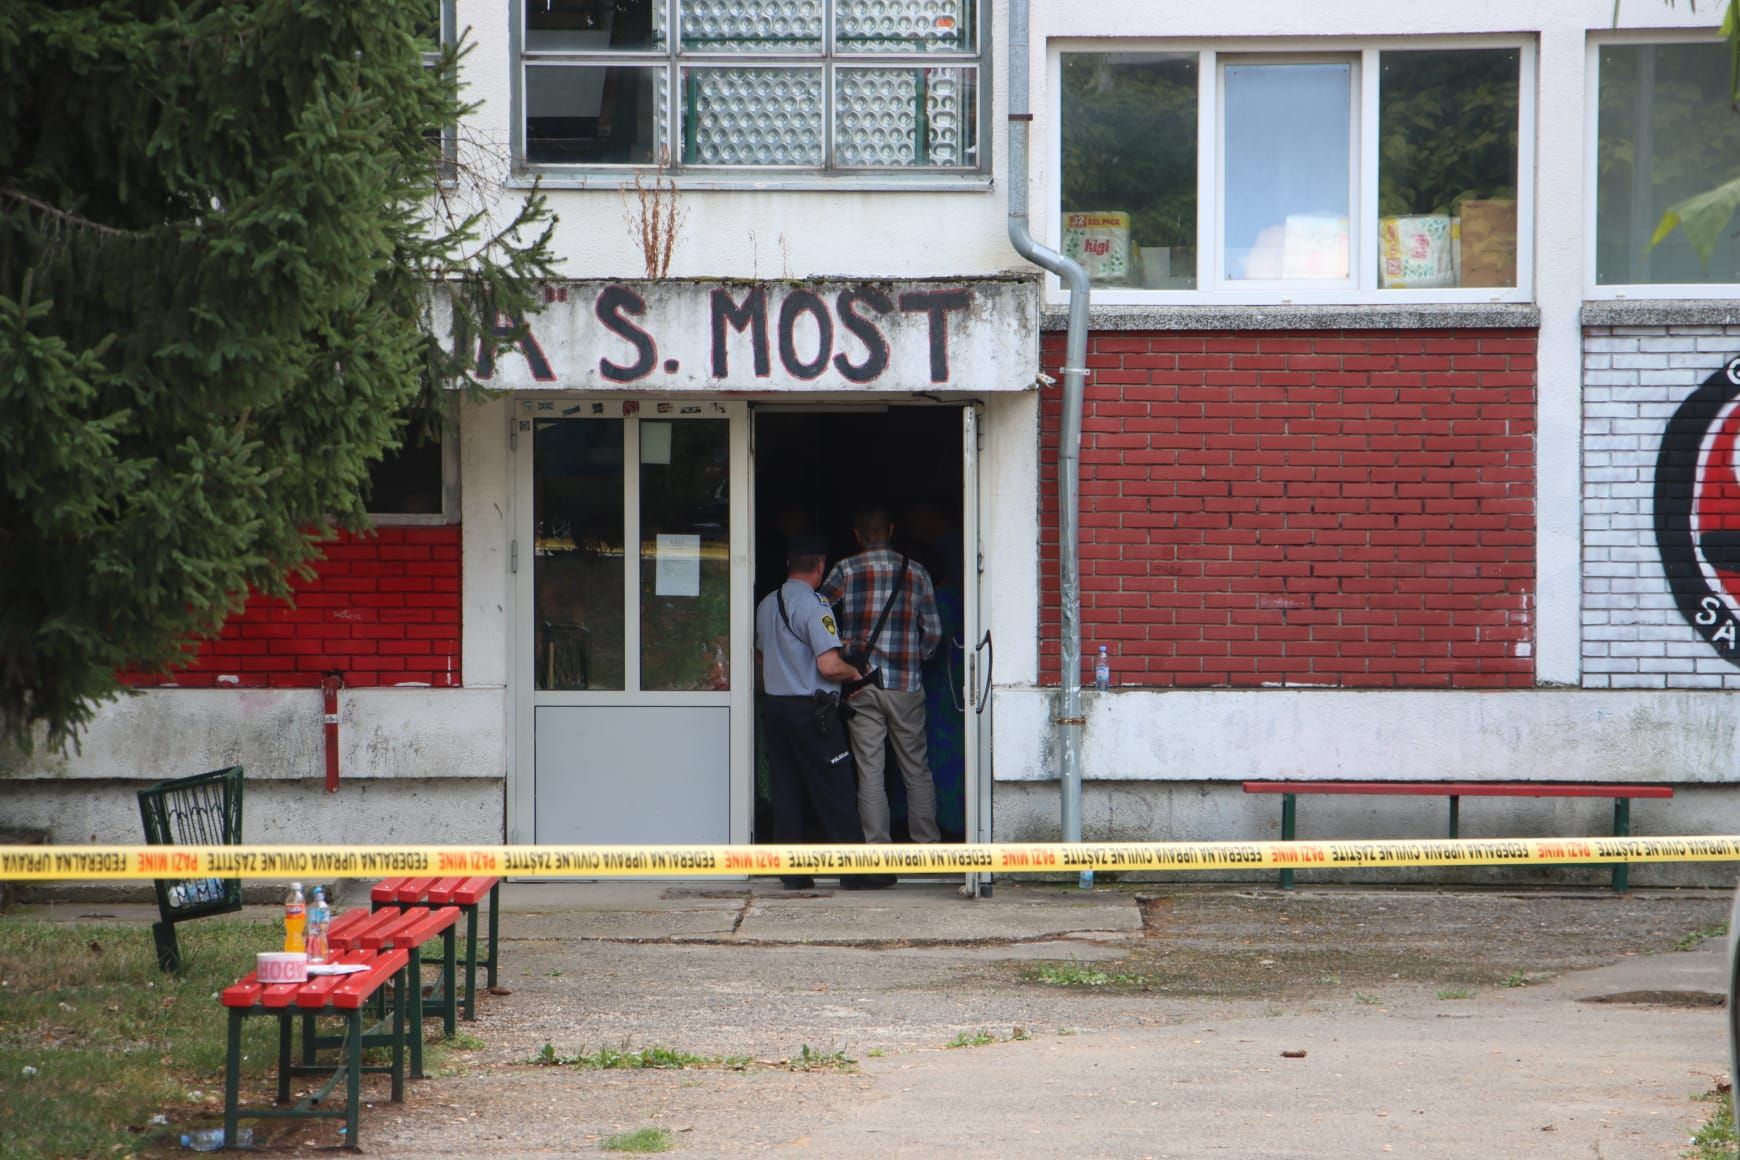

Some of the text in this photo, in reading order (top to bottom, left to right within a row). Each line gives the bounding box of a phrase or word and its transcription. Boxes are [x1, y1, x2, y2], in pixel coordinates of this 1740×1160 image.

[595, 284, 680, 384] S.
[710, 284, 972, 384] MOST
[1156, 847, 1198, 864] UPRAVA
[1201, 846, 1263, 864] FEDERALNA
[1271, 846, 1298, 863] MINE
[1301, 845, 1325, 862] PAZI
[1379, 844, 1421, 861] CIVILNE
[1423, 844, 1465, 860] UPRAVA
[1468, 843, 1529, 859] FEDERALNA
[1537, 842, 1565, 859] MINE
[1567, 842, 1591, 858] PAZI
[1644, 840, 1686, 857] CIVILNE
[1688, 839, 1731, 855] UPRAVA
[0, 851, 53, 872] UPRAVA
[55, 851, 129, 872] FEDERALNA
[135, 851, 168, 872] MINE
[169, 852, 200, 872] PAZI
[259, 852, 308, 871] CIVILNE
[310, 851, 358, 871] UPRAVA
[359, 851, 429, 871] FEDERALNA
[437, 851, 468, 870] MINE
[470, 851, 497, 870] PAZI
[555, 851, 600, 870] CIVILNE
[602, 850, 648, 869] UPRAVA
[650, 850, 716, 869] FEDERALNA
[724, 850, 753, 869] MINE
[755, 850, 781, 869] PAZI
[837, 850, 881, 868] CIVILNE
[883, 849, 927, 867] UPRAVA
[929, 849, 993, 867] FEDERALNA
[1001, 849, 1029, 866] MINE
[1031, 848, 1055, 866] PAZI
[1111, 848, 1153, 865] CIVILNE
